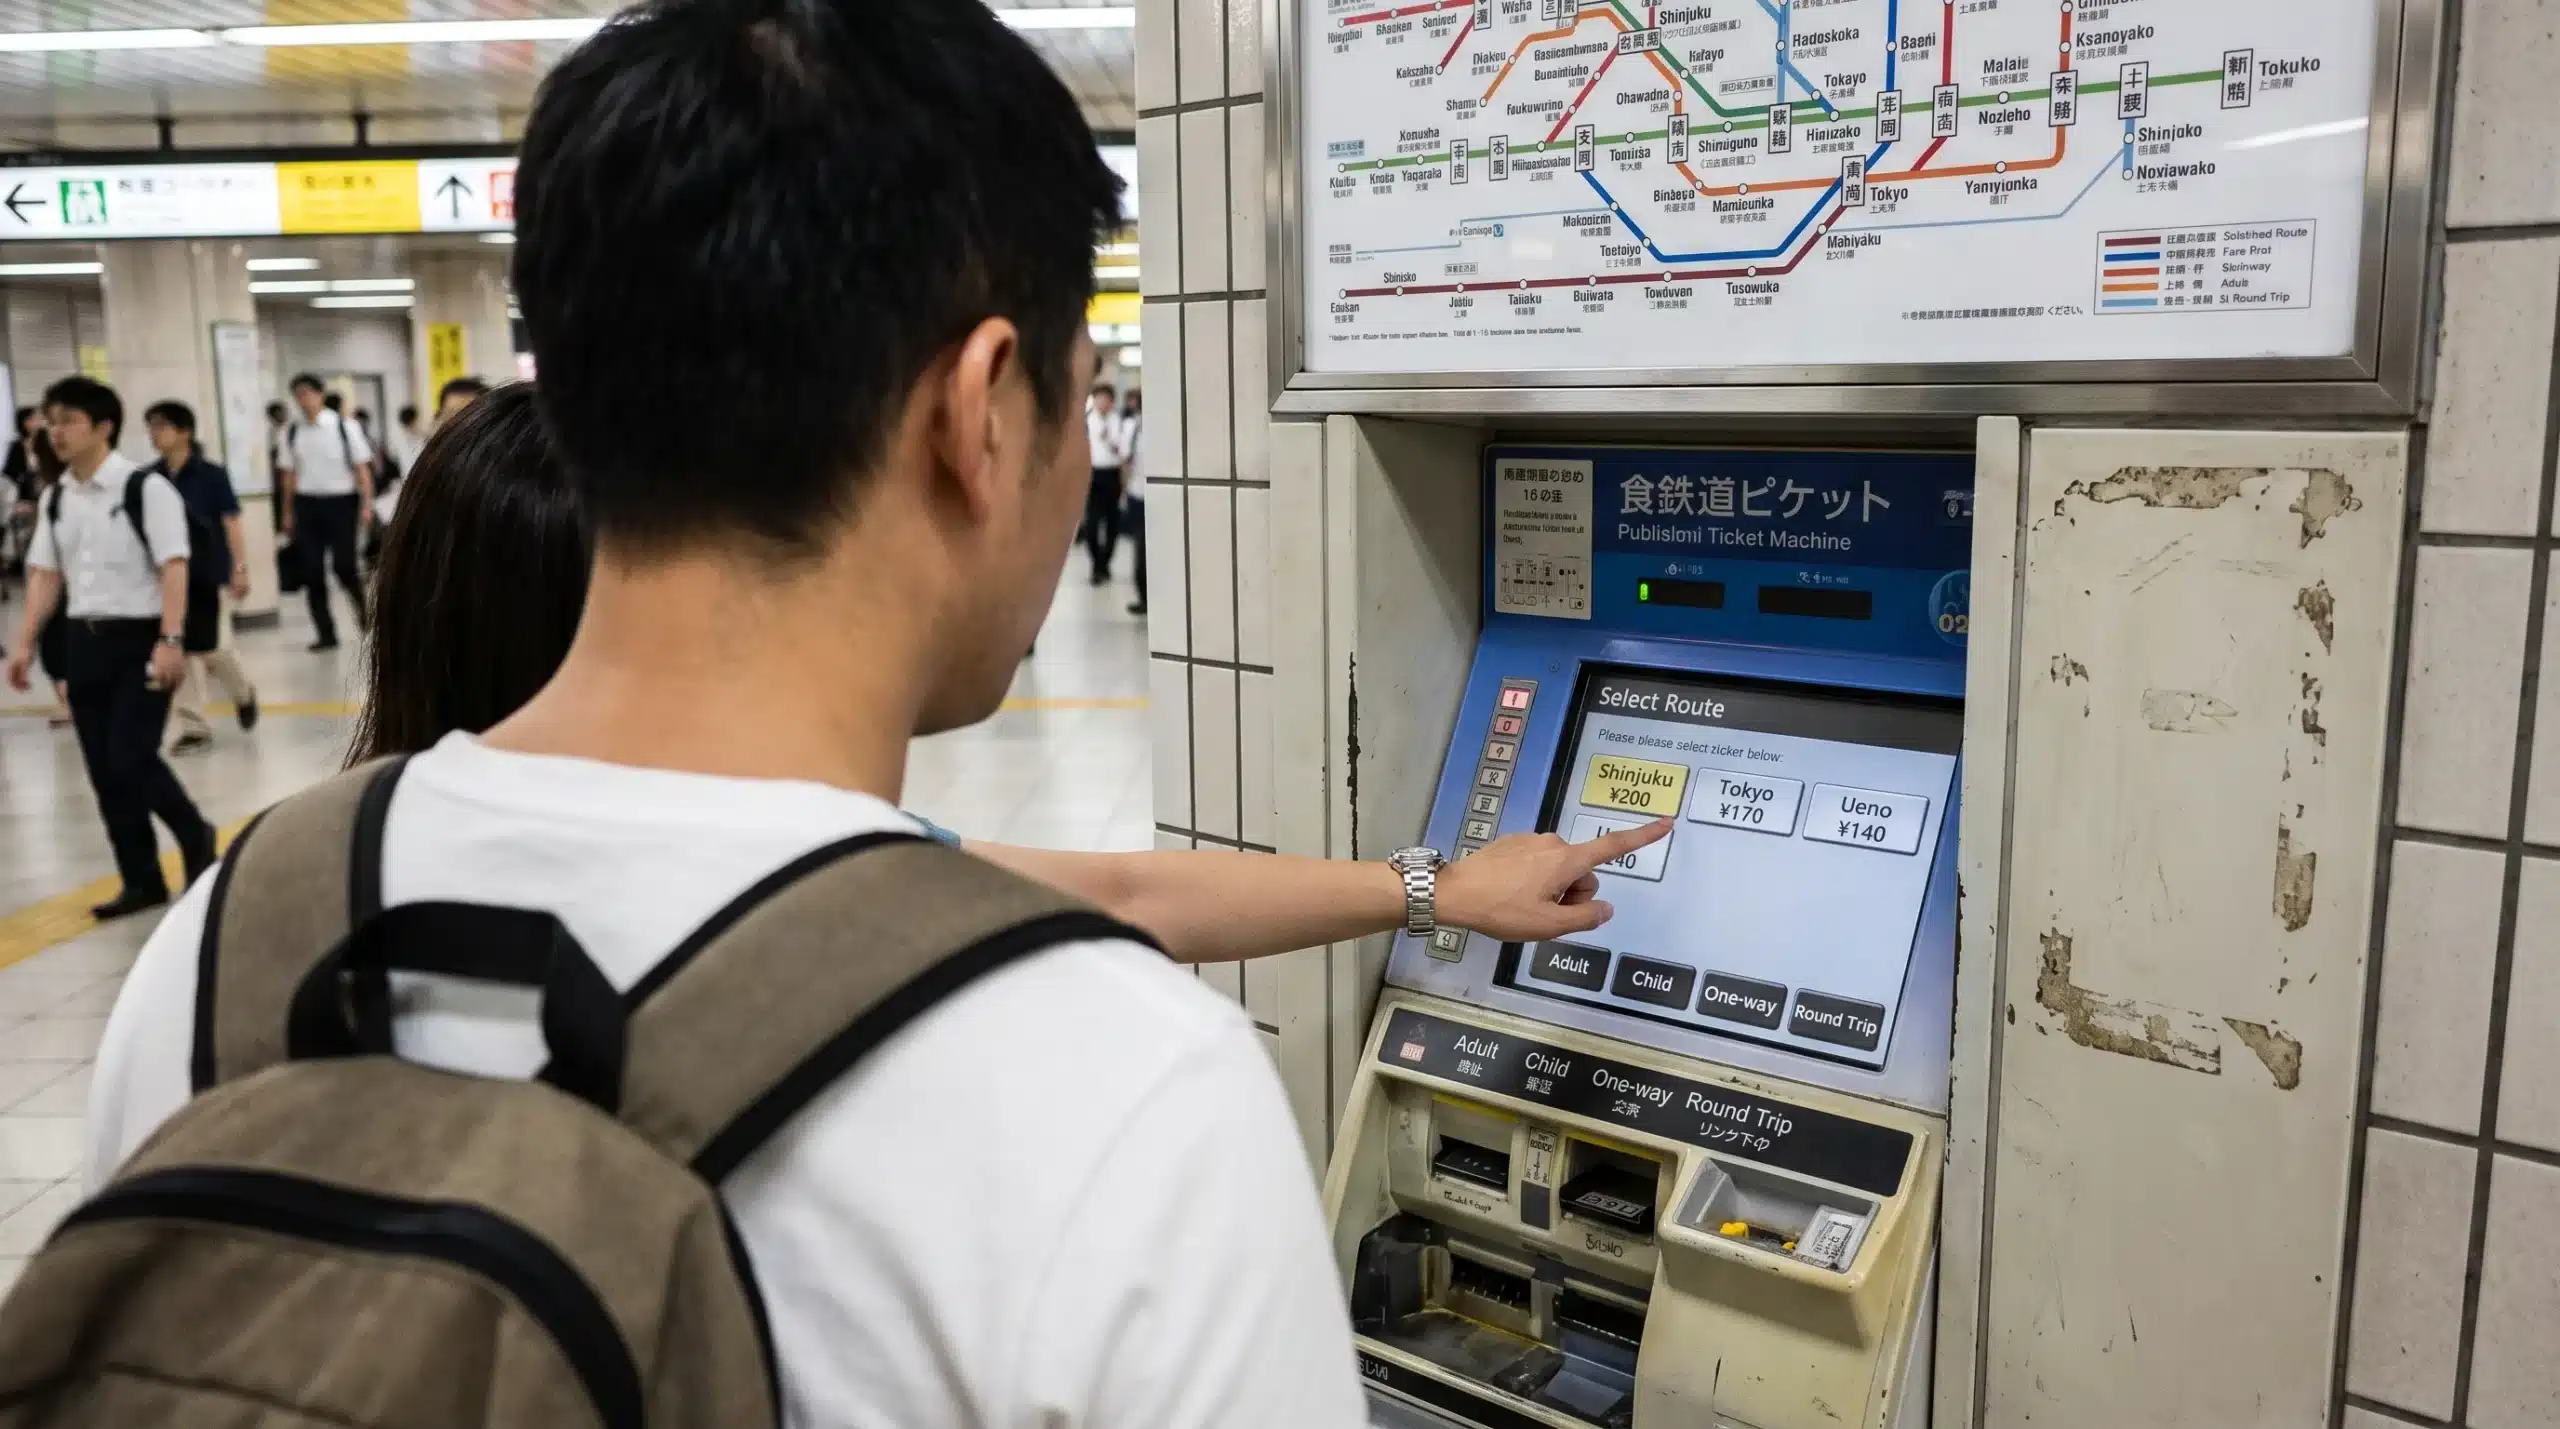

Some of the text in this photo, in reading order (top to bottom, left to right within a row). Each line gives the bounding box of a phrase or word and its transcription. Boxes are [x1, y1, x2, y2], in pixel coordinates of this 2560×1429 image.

[1659, 5, 1712, 25] Shinjuku
[2259, 58, 2320, 76] Tokuko
[1824, 72, 1866, 88] Tokayo
[1870, 186, 1909, 202] Tokyo
[2275, 228, 2308, 238] Route
[2222, 246, 2246, 257] Fare
[2233, 293, 2267, 304] Round
[2270, 292, 2290, 304] Trip
[1619, 473, 1891, 522] 食鉄道ピケット
[1708, 526, 1764, 547] Ticket
[1770, 530, 1851, 551] Machine
[1599, 686, 1725, 718] Select Route
[1598, 728, 1635, 744] Please
[1675, 740, 1708, 754] select
[1599, 763, 1674, 788] Shinjuku
[1609, 788, 1651, 807] ¥200
[1720, 779, 1774, 803] Tokyo
[1719, 803, 1764, 824] ¥170
[1841, 796, 1892, 818] Ueno
[1838, 820, 1886, 842] ¥140
[1549, 953, 1590, 975] Adult
[1632, 971, 1673, 993] Child
[1704, 985, 1778, 1014] One-way
[1795, 1005, 1877, 1037] Round Trip
[1454, 1035, 1793, 1137] Adult Child One-way Round Trip
